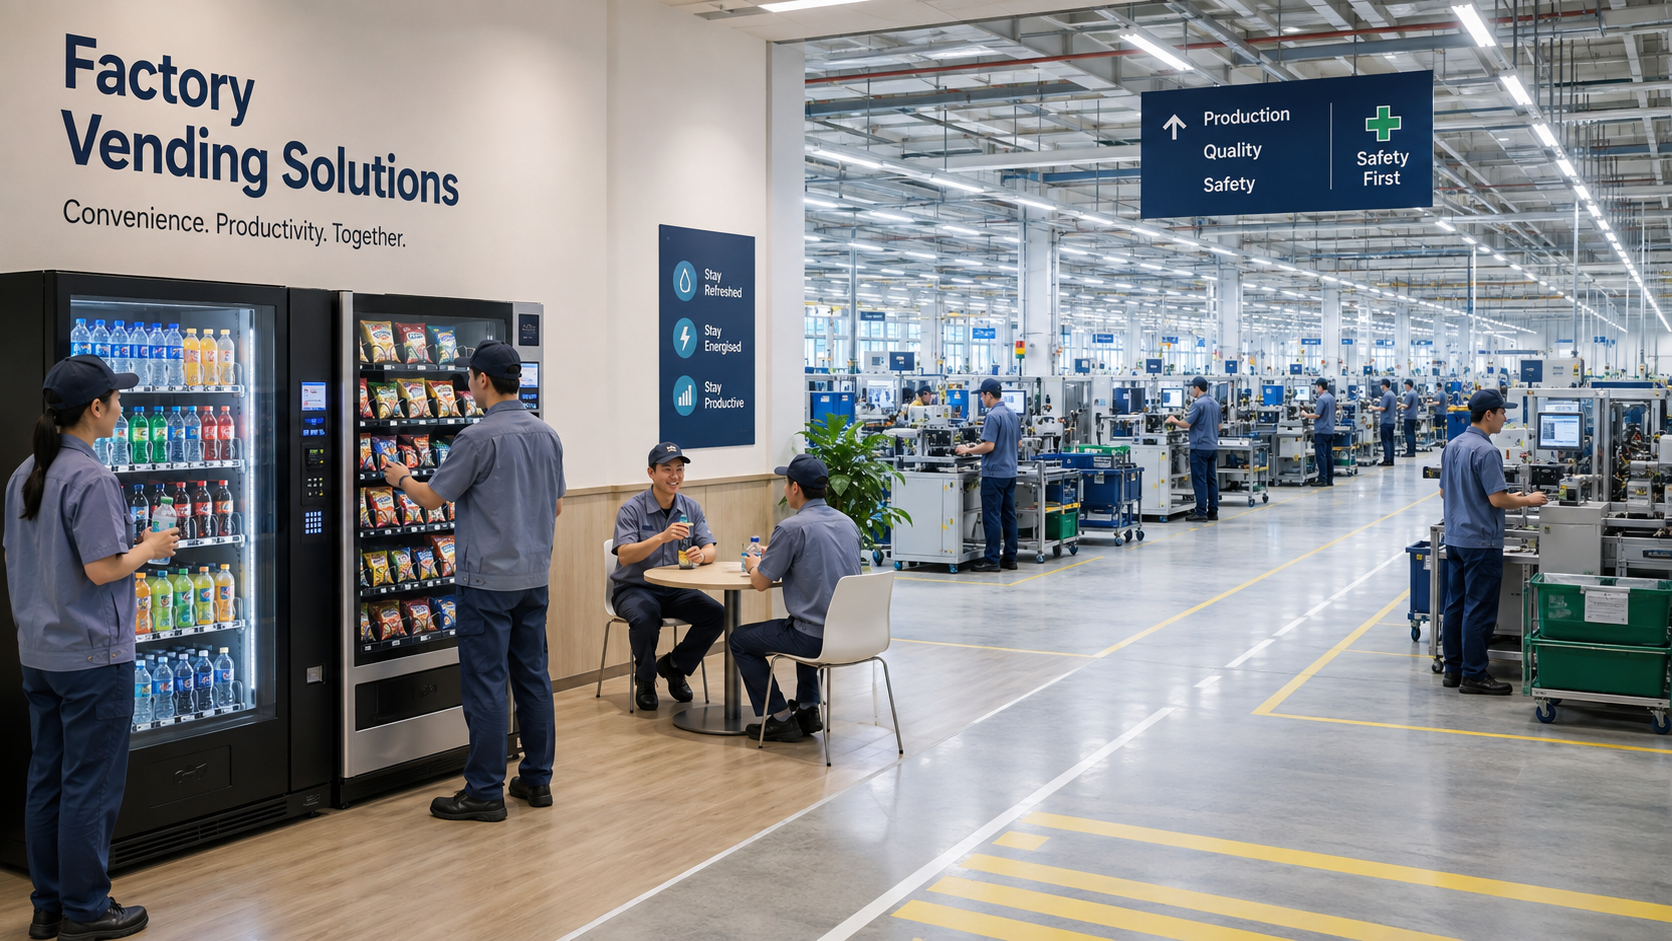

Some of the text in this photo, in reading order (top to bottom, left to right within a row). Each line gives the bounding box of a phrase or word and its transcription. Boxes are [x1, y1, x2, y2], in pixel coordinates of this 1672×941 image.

[66, 33, 255, 127] Factory
[1205, 107, 1289, 126] Production
[61, 109, 458, 206] Vending Solutions
[1204, 142, 1262, 160] Quality
[1357, 150, 1409, 167] Safety
[1204, 176, 1255, 194] Safety
[1364, 171, 1400, 186] First
[64, 199, 405, 249] Convenience. Productivity. Together.
[705, 268, 722, 283] Stay
[705, 284, 742, 298] Refreshed
[705, 324, 722, 339] Stay
[705, 340, 741, 355] Energised
[705, 381, 722, 395] Stay
[705, 397, 744, 409] Productive
